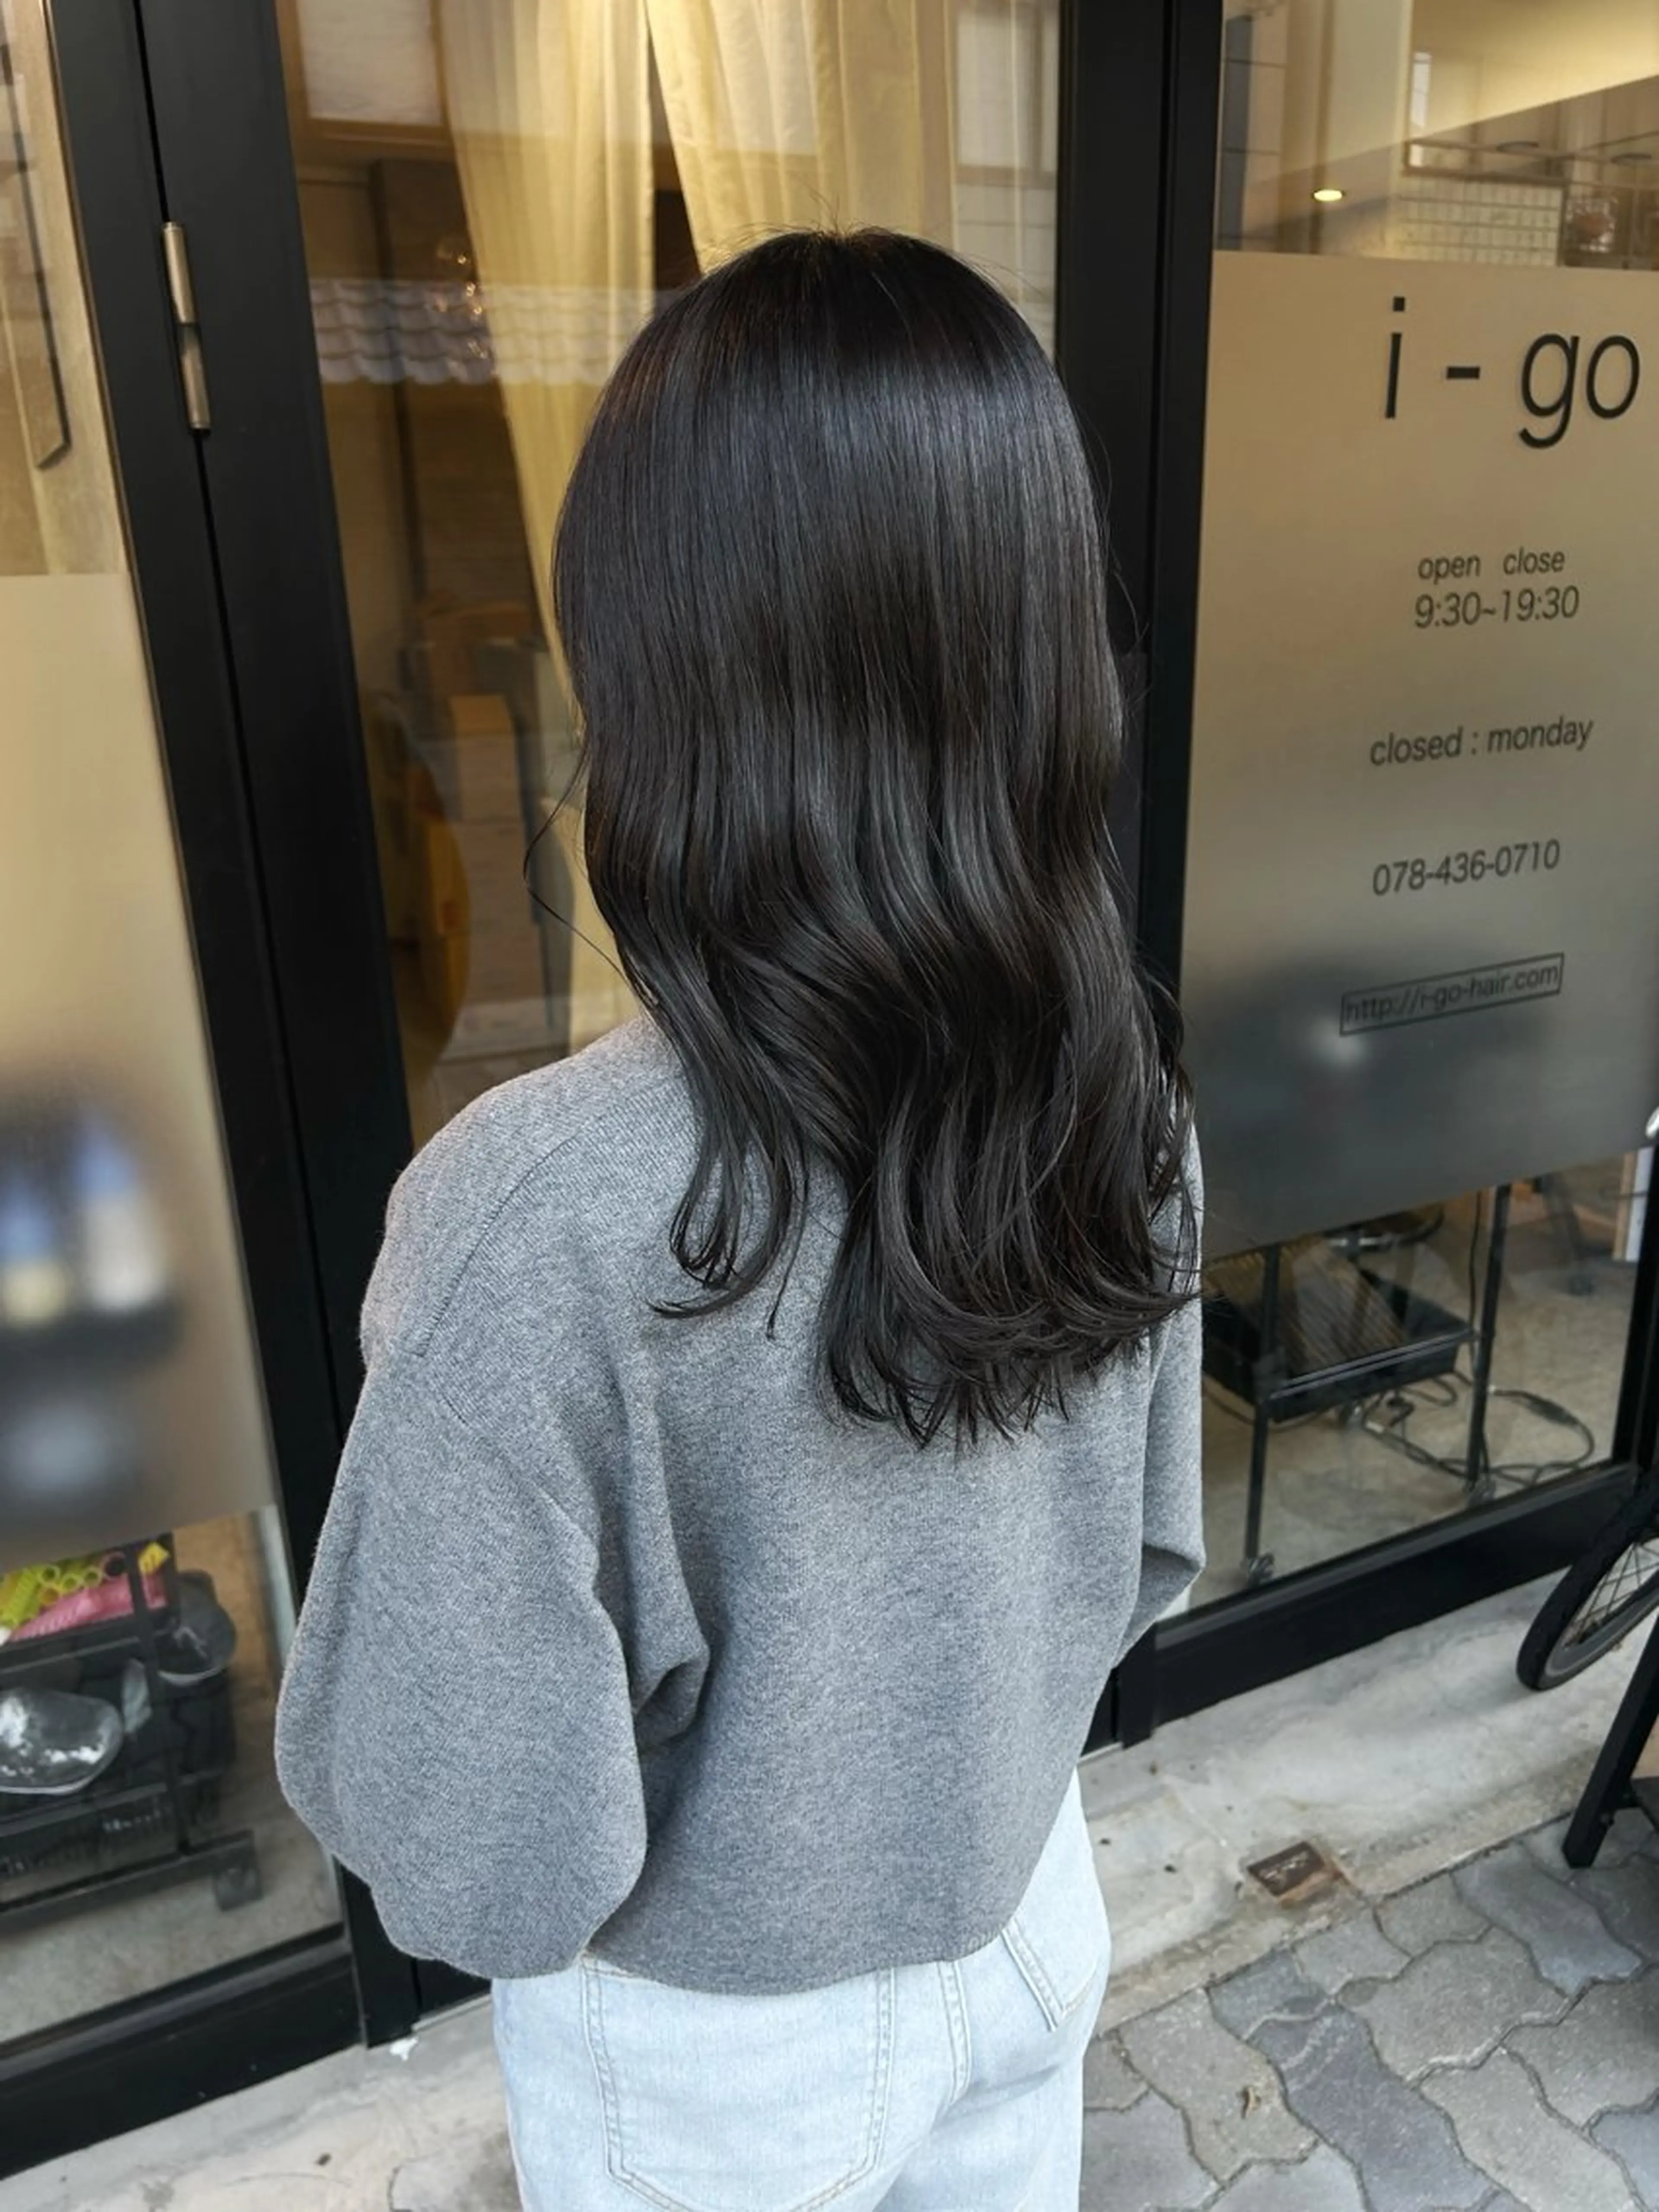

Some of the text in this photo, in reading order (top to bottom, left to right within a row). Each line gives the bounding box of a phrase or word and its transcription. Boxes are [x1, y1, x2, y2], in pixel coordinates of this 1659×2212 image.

[1385, 296, 1406, 419] i
[1518, 333, 1640, 450] go
[1417, 547, 1566, 585] open close
[1414, 585, 1580, 629] 9:30~19:30
[1370, 725, 1464, 767] closed
[1487, 715, 1594, 753] monday
[1372, 839, 1561, 896] 078-436-0710
